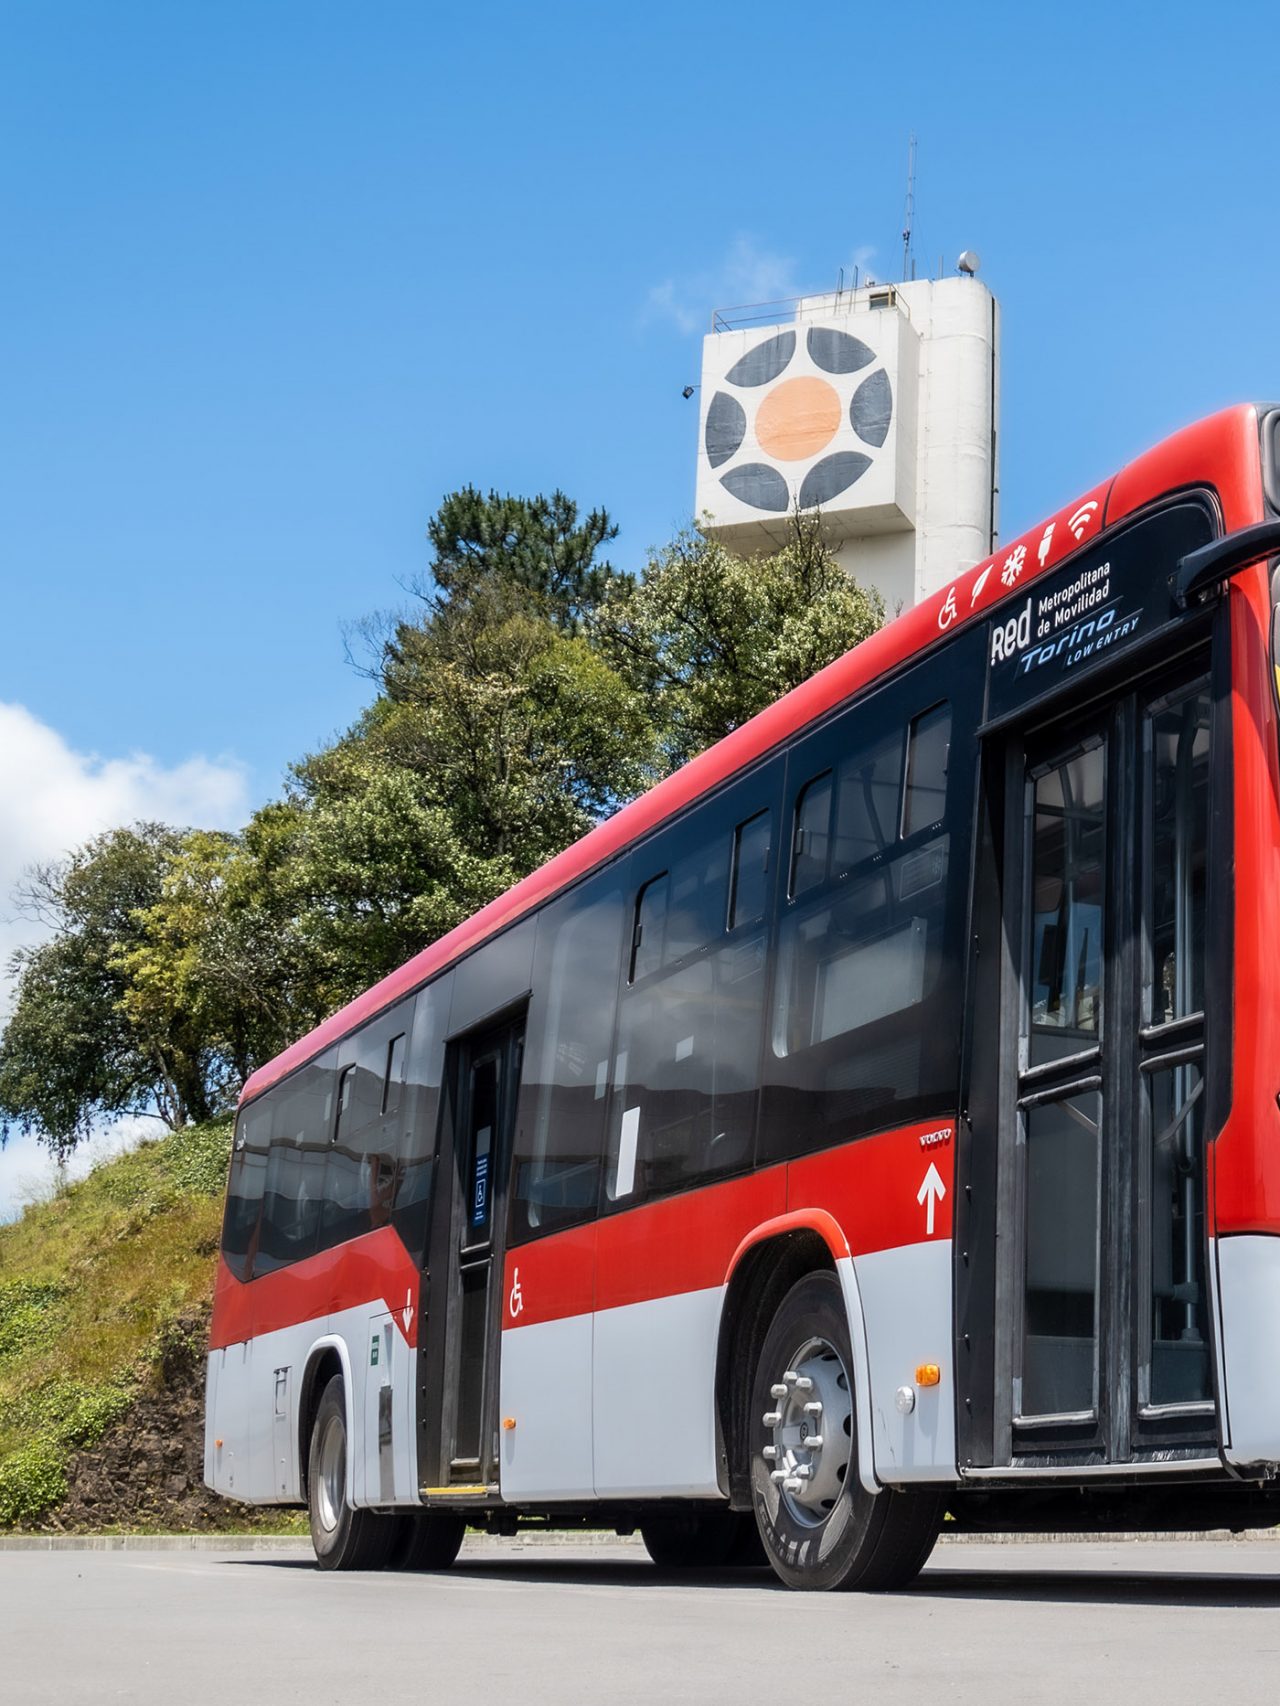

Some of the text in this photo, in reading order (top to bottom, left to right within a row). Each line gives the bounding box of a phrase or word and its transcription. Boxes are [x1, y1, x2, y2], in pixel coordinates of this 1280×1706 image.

[1037, 579, 1110, 637] de Movilidad
[1038, 562, 1110, 616] Metropolitana
[990, 597, 1032, 666] Red
[1021, 609, 1116, 673] Torino
[1066, 617, 1140, 666] LOW ENTRY
[919, 1128, 952, 1147] VOLVO
